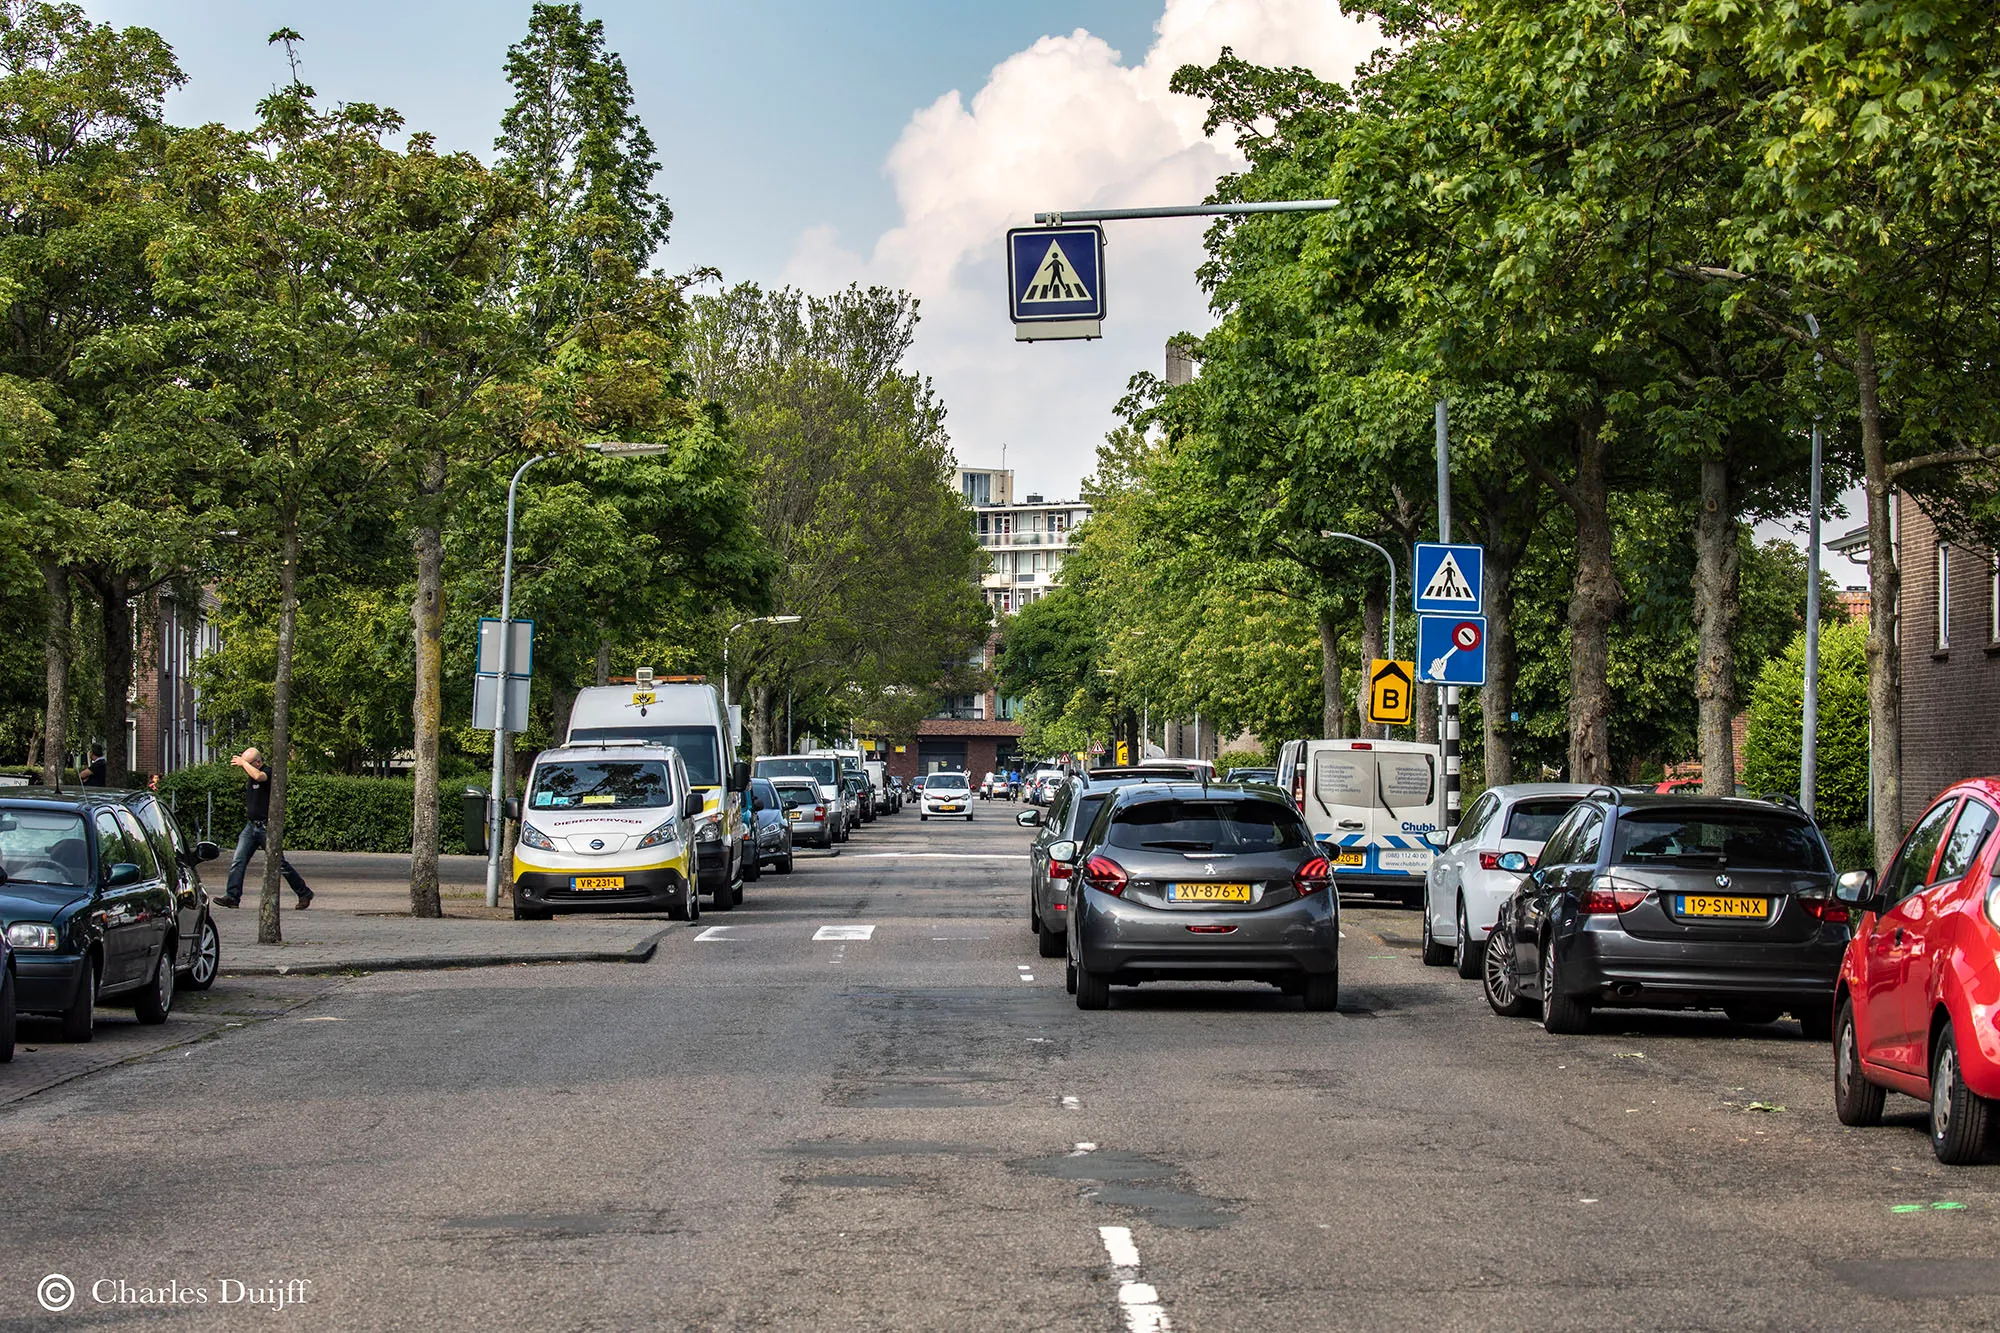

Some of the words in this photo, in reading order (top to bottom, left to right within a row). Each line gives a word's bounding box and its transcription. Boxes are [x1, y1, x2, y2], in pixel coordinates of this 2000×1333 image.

[1382, 689, 1399, 709] B
[554, 818, 642, 827] DIERENVERVOER
[1401, 821, 1436, 832] Chubb
[580, 879, 619, 887] VR-231-L
[1181, 885, 1244, 898] XV-876-X
[1691, 898, 1761, 913] 19-SN-NX
